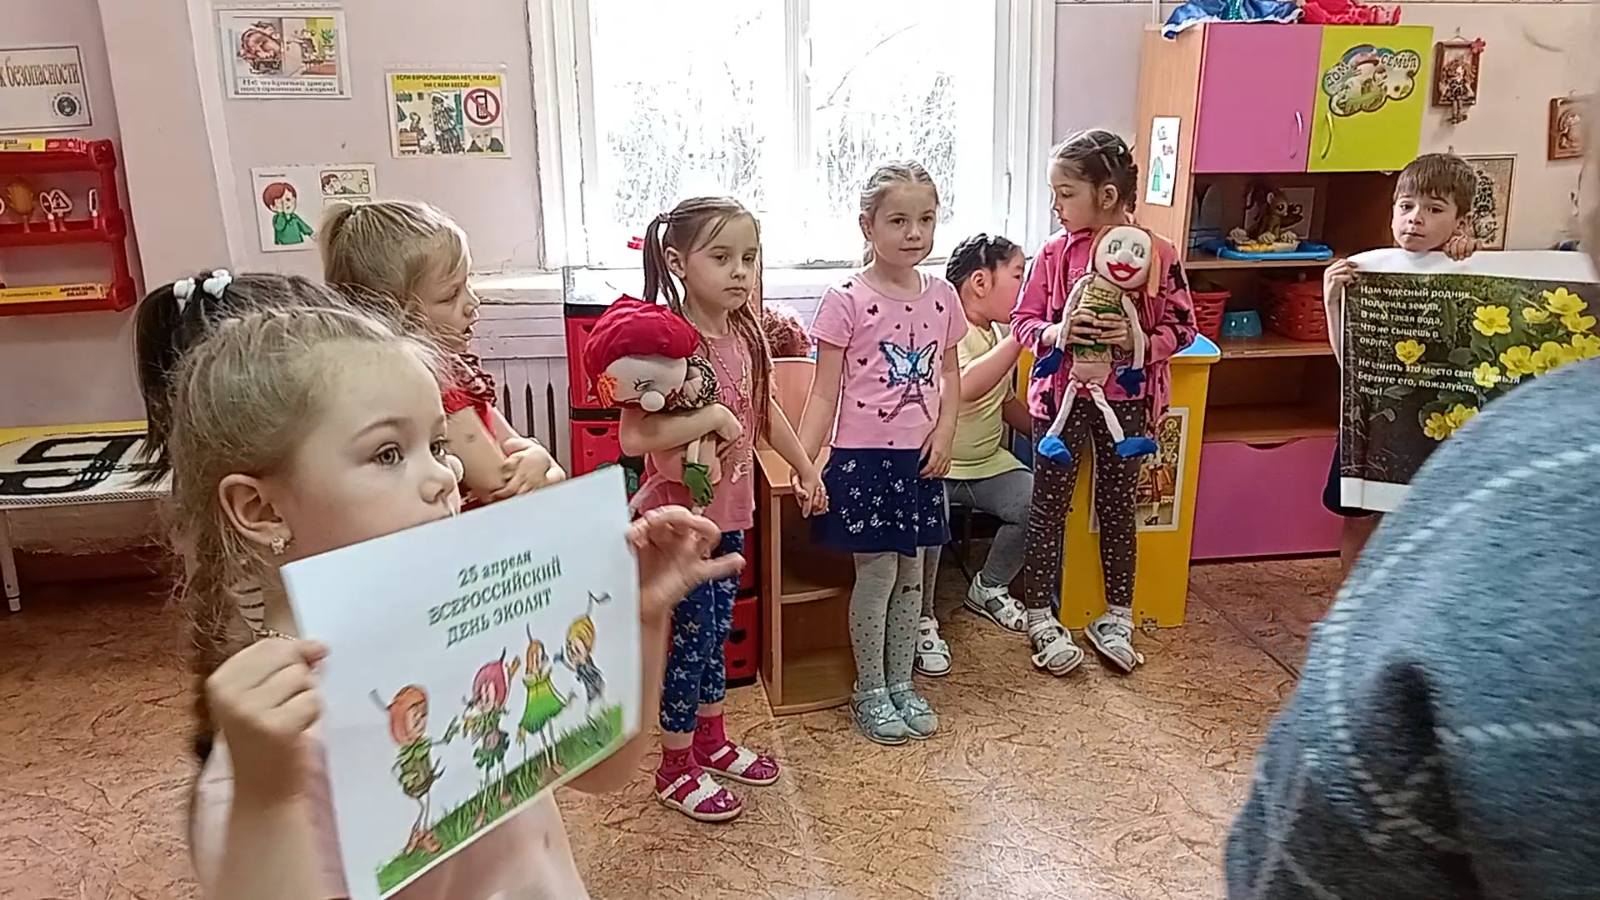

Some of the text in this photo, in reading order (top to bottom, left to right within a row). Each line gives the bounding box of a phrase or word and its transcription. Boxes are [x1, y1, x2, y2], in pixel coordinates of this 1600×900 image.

[5, 56, 80, 87] безопасности
[1360, 286, 1471, 299] Нам чудесный родник
[1360, 298, 1407, 309] Подарила
[1390, 314, 1415, 322] такая
[1360, 323, 1376, 332] Что
[1422, 367, 1453, 377] место
[457, 550, 532, 588] 25 апреля
[427, 555, 562, 626] ВСЕРОССИЙСКИЙ
[446, 587, 551, 649] ДЕНЬ ЭКОЛЯТ
